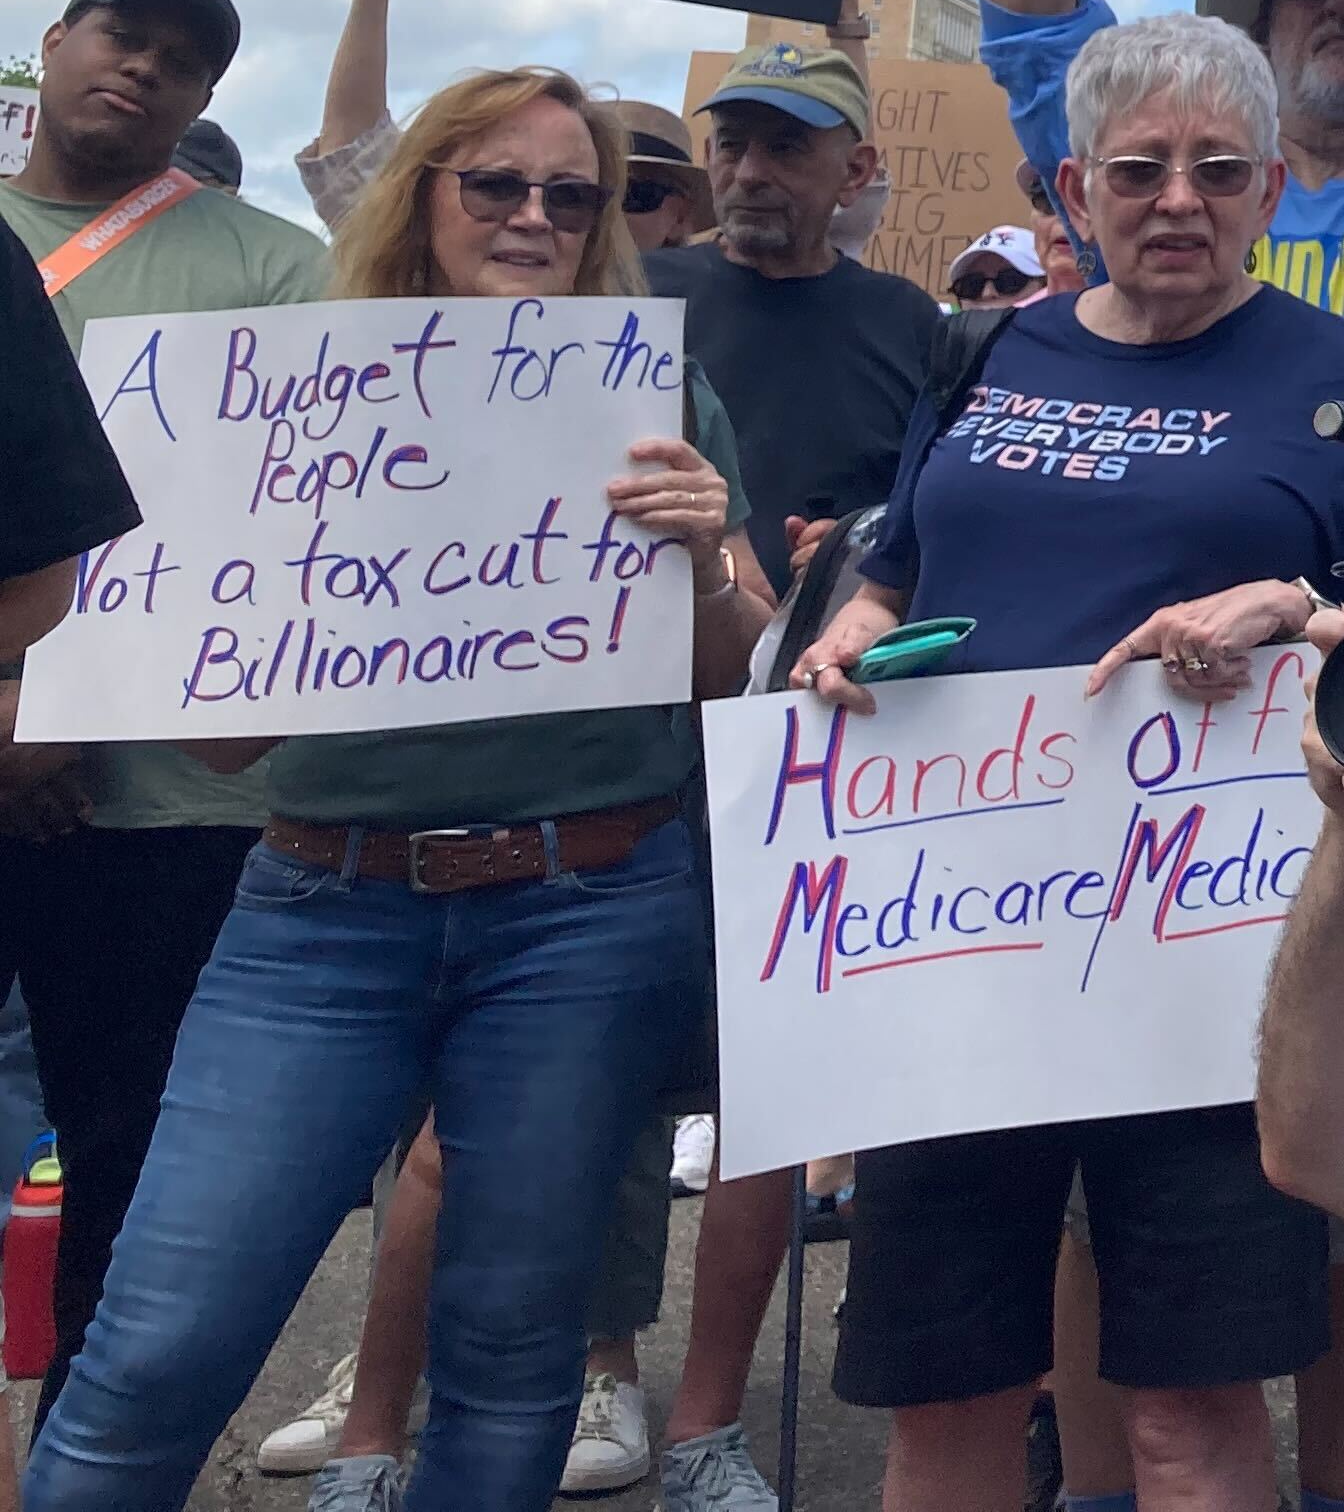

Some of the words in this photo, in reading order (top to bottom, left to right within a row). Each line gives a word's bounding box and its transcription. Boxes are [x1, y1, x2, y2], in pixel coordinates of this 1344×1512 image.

[100, 330, 177, 441] A
[217, 310, 456, 439] Budget
[487, 299, 586, 405] for
[596, 311, 683, 392] the
[249, 419, 450, 519] People
[969, 439, 1130, 482] VOTES
[211, 561, 257, 607] a
[284, 521, 412, 609] tax
[423, 497, 568, 596] cut
[181, 587, 630, 710] Billionaires!
[763, 694, 1078, 846] Hands
